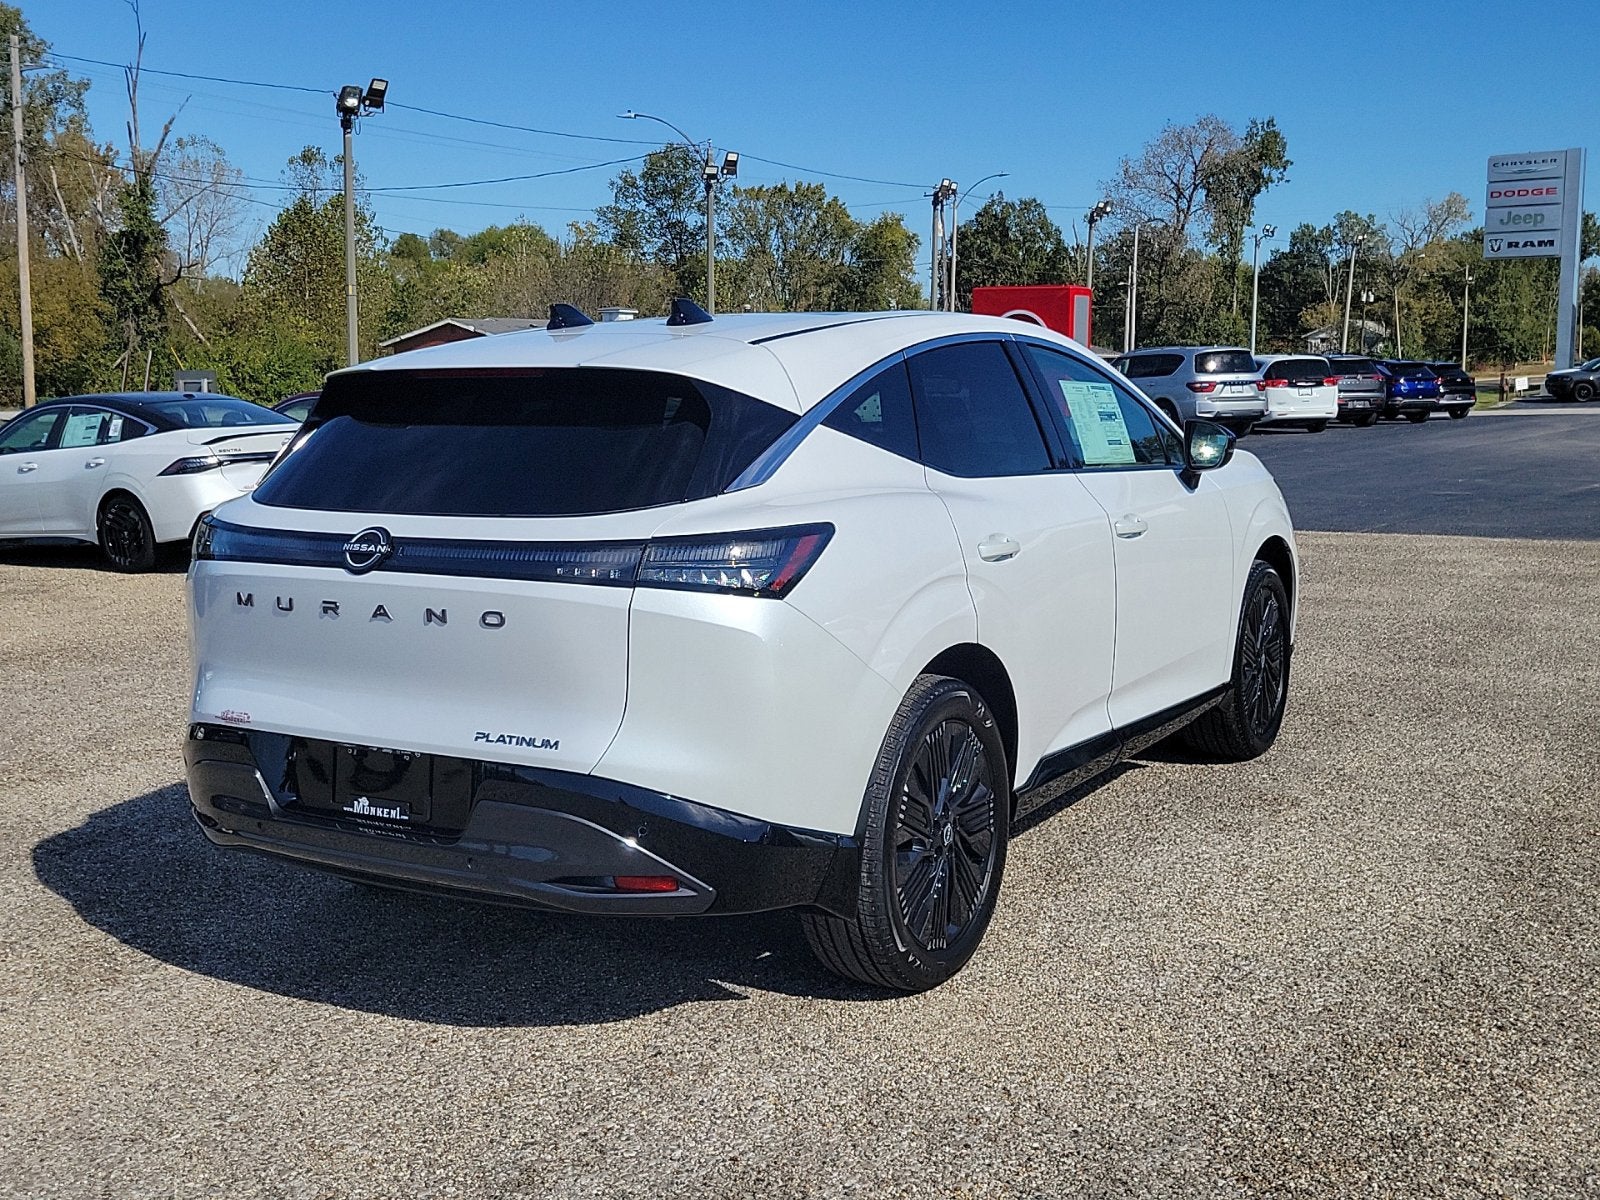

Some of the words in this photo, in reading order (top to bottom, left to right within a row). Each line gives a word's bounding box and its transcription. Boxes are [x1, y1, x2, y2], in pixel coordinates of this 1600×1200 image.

[1492, 158, 1557, 168] CHRYSLER
[1490, 187, 1558, 199] DODGE
[1500, 211, 1545, 227] Jeep
[1507, 240, 1555, 248] RAM
[342, 543, 387, 553] NISSAN
[236, 591, 506, 628] MURANO
[474, 731, 560, 751] PLATINUM
